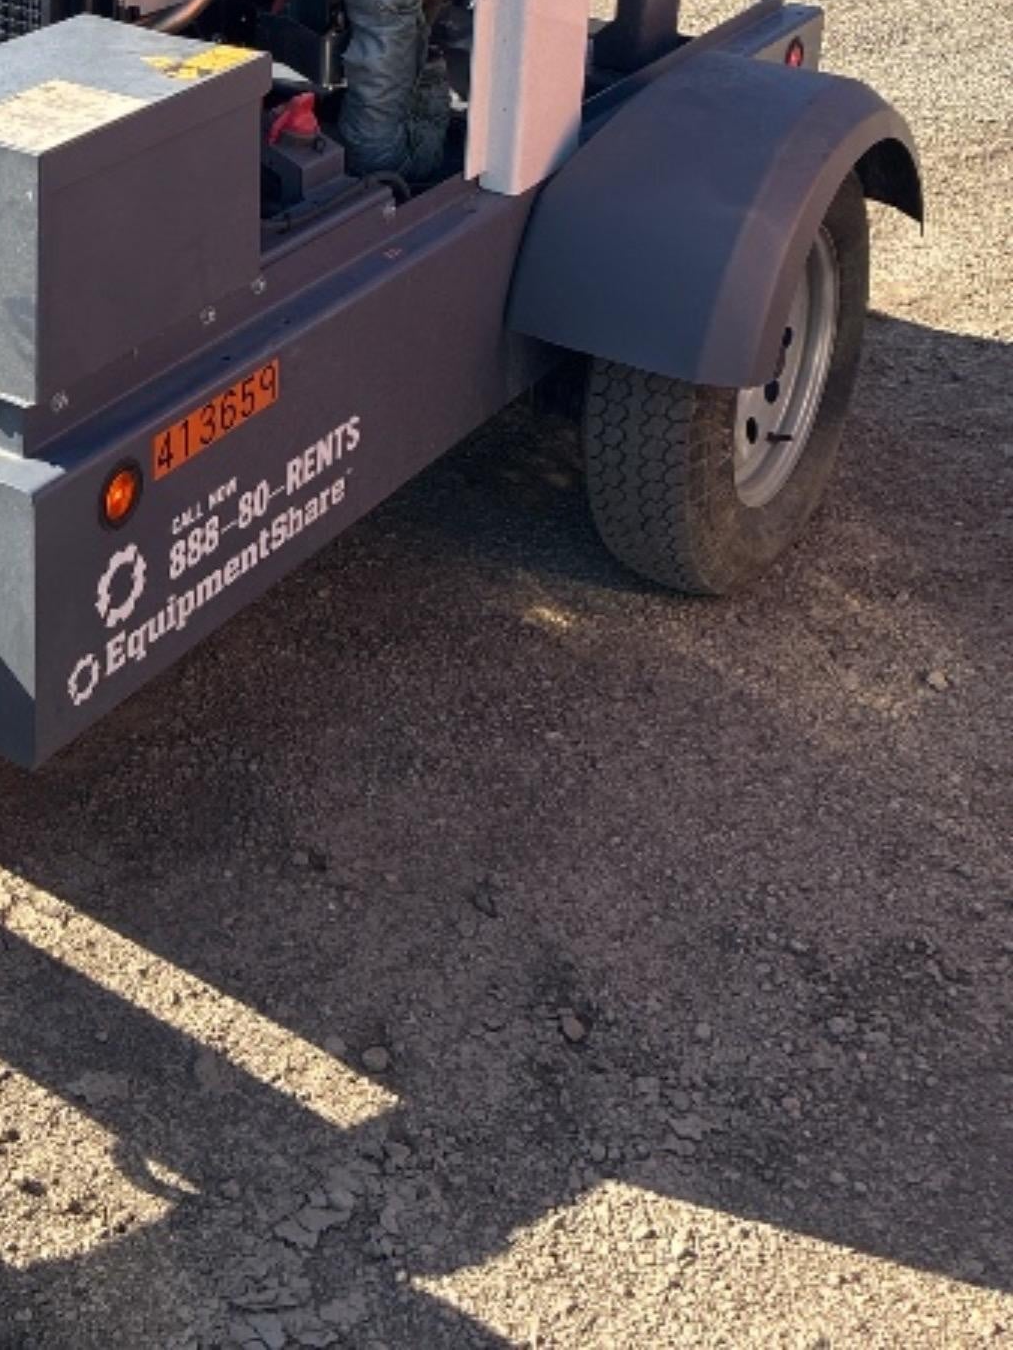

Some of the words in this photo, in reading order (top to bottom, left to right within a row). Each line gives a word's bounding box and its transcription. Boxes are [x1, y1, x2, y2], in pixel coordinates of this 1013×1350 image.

[156, 362, 277, 469] 413659
[172, 501, 203, 535] CALL
[105, 476, 346, 676] EquipmentShare
